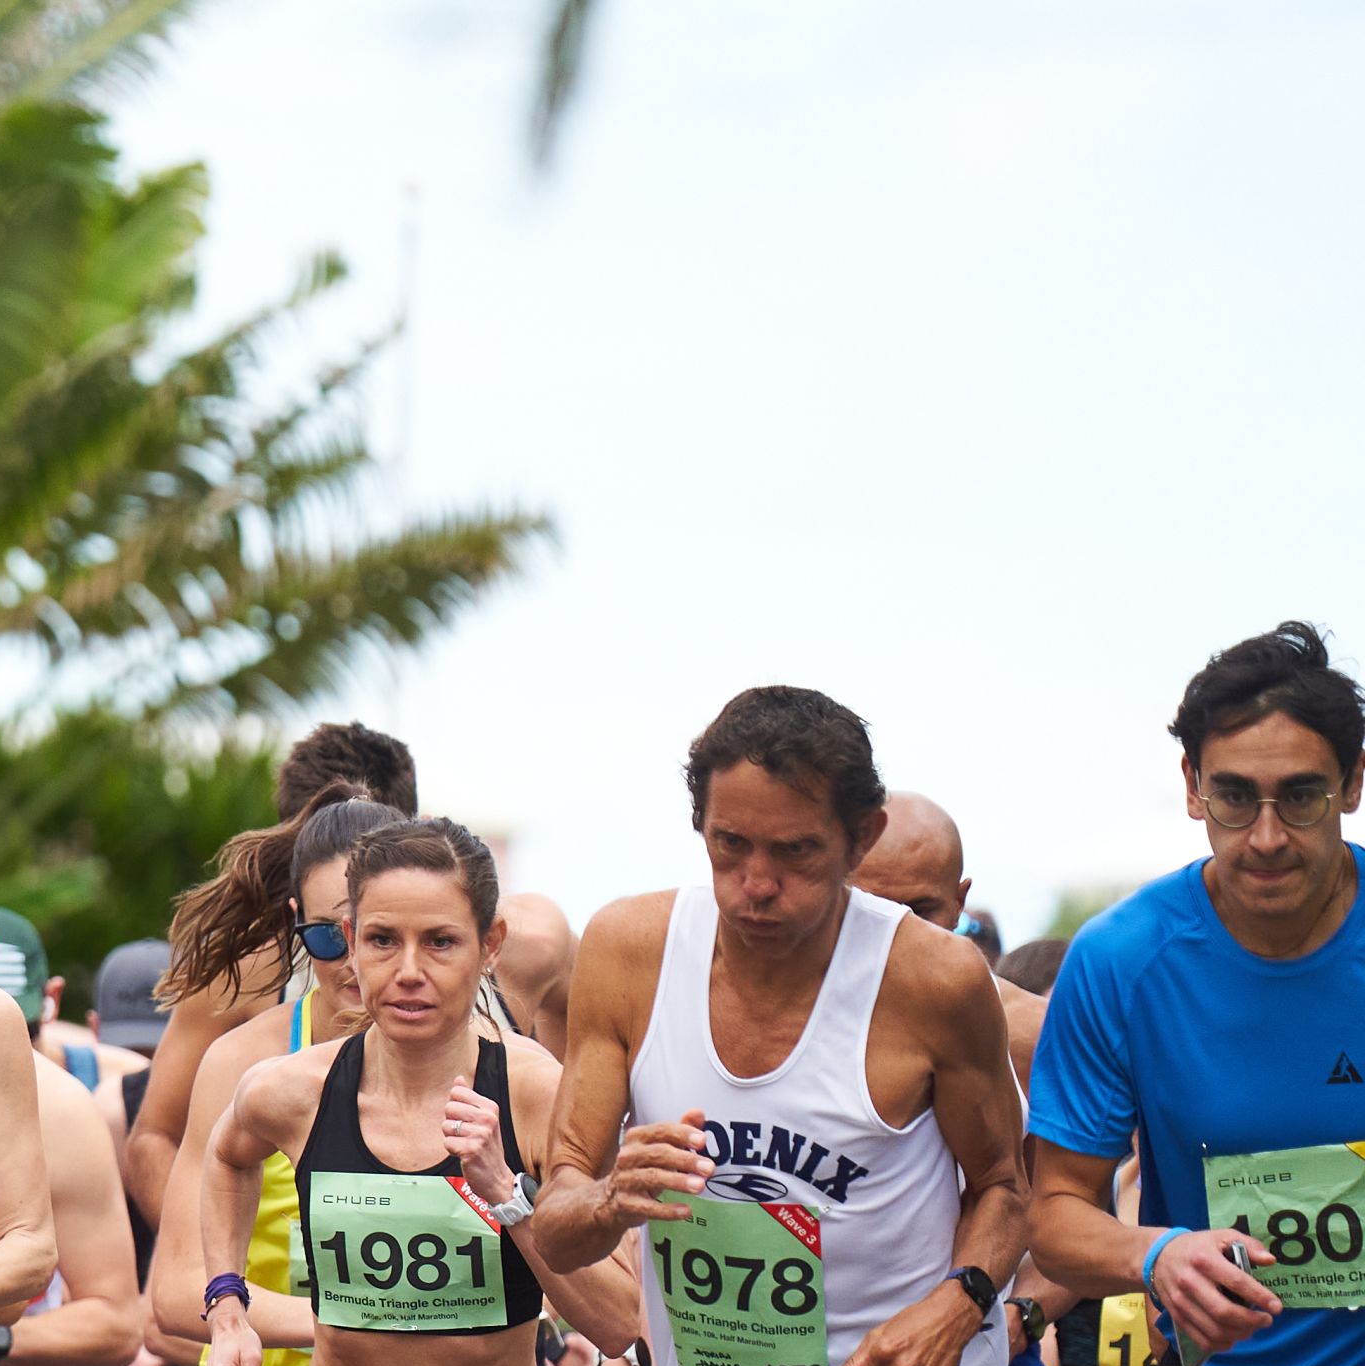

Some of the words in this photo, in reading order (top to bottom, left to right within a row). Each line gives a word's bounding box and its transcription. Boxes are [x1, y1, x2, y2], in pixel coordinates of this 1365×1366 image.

[699, 1120, 869, 1204] OENIX
[1218, 1172, 1293, 1188] CHUBB
[322, 1194, 391, 1206] CHUBB
[460, 1181, 489, 1213] Wave
[778, 1206, 807, 1237] Wave
[805, 1234, 817, 1245] 3
[320, 1231, 486, 1292] 1981
[653, 1236, 818, 1316] 1978
[1291, 1271, 1345, 1286] Triangle
[324, 1290, 376, 1308] Bermuda
[378, 1298, 429, 1311] Triangle
[432, 1295, 496, 1308] Challenge
[1316, 1290, 1333, 1298] Half
[418, 1312, 459, 1320] Marathon)
[699, 1312, 748, 1331] Triangle
[751, 1322, 815, 1336] Challenge
[719, 1333, 736, 1343] Half
[737, 1336, 776, 1349] Marathon)
